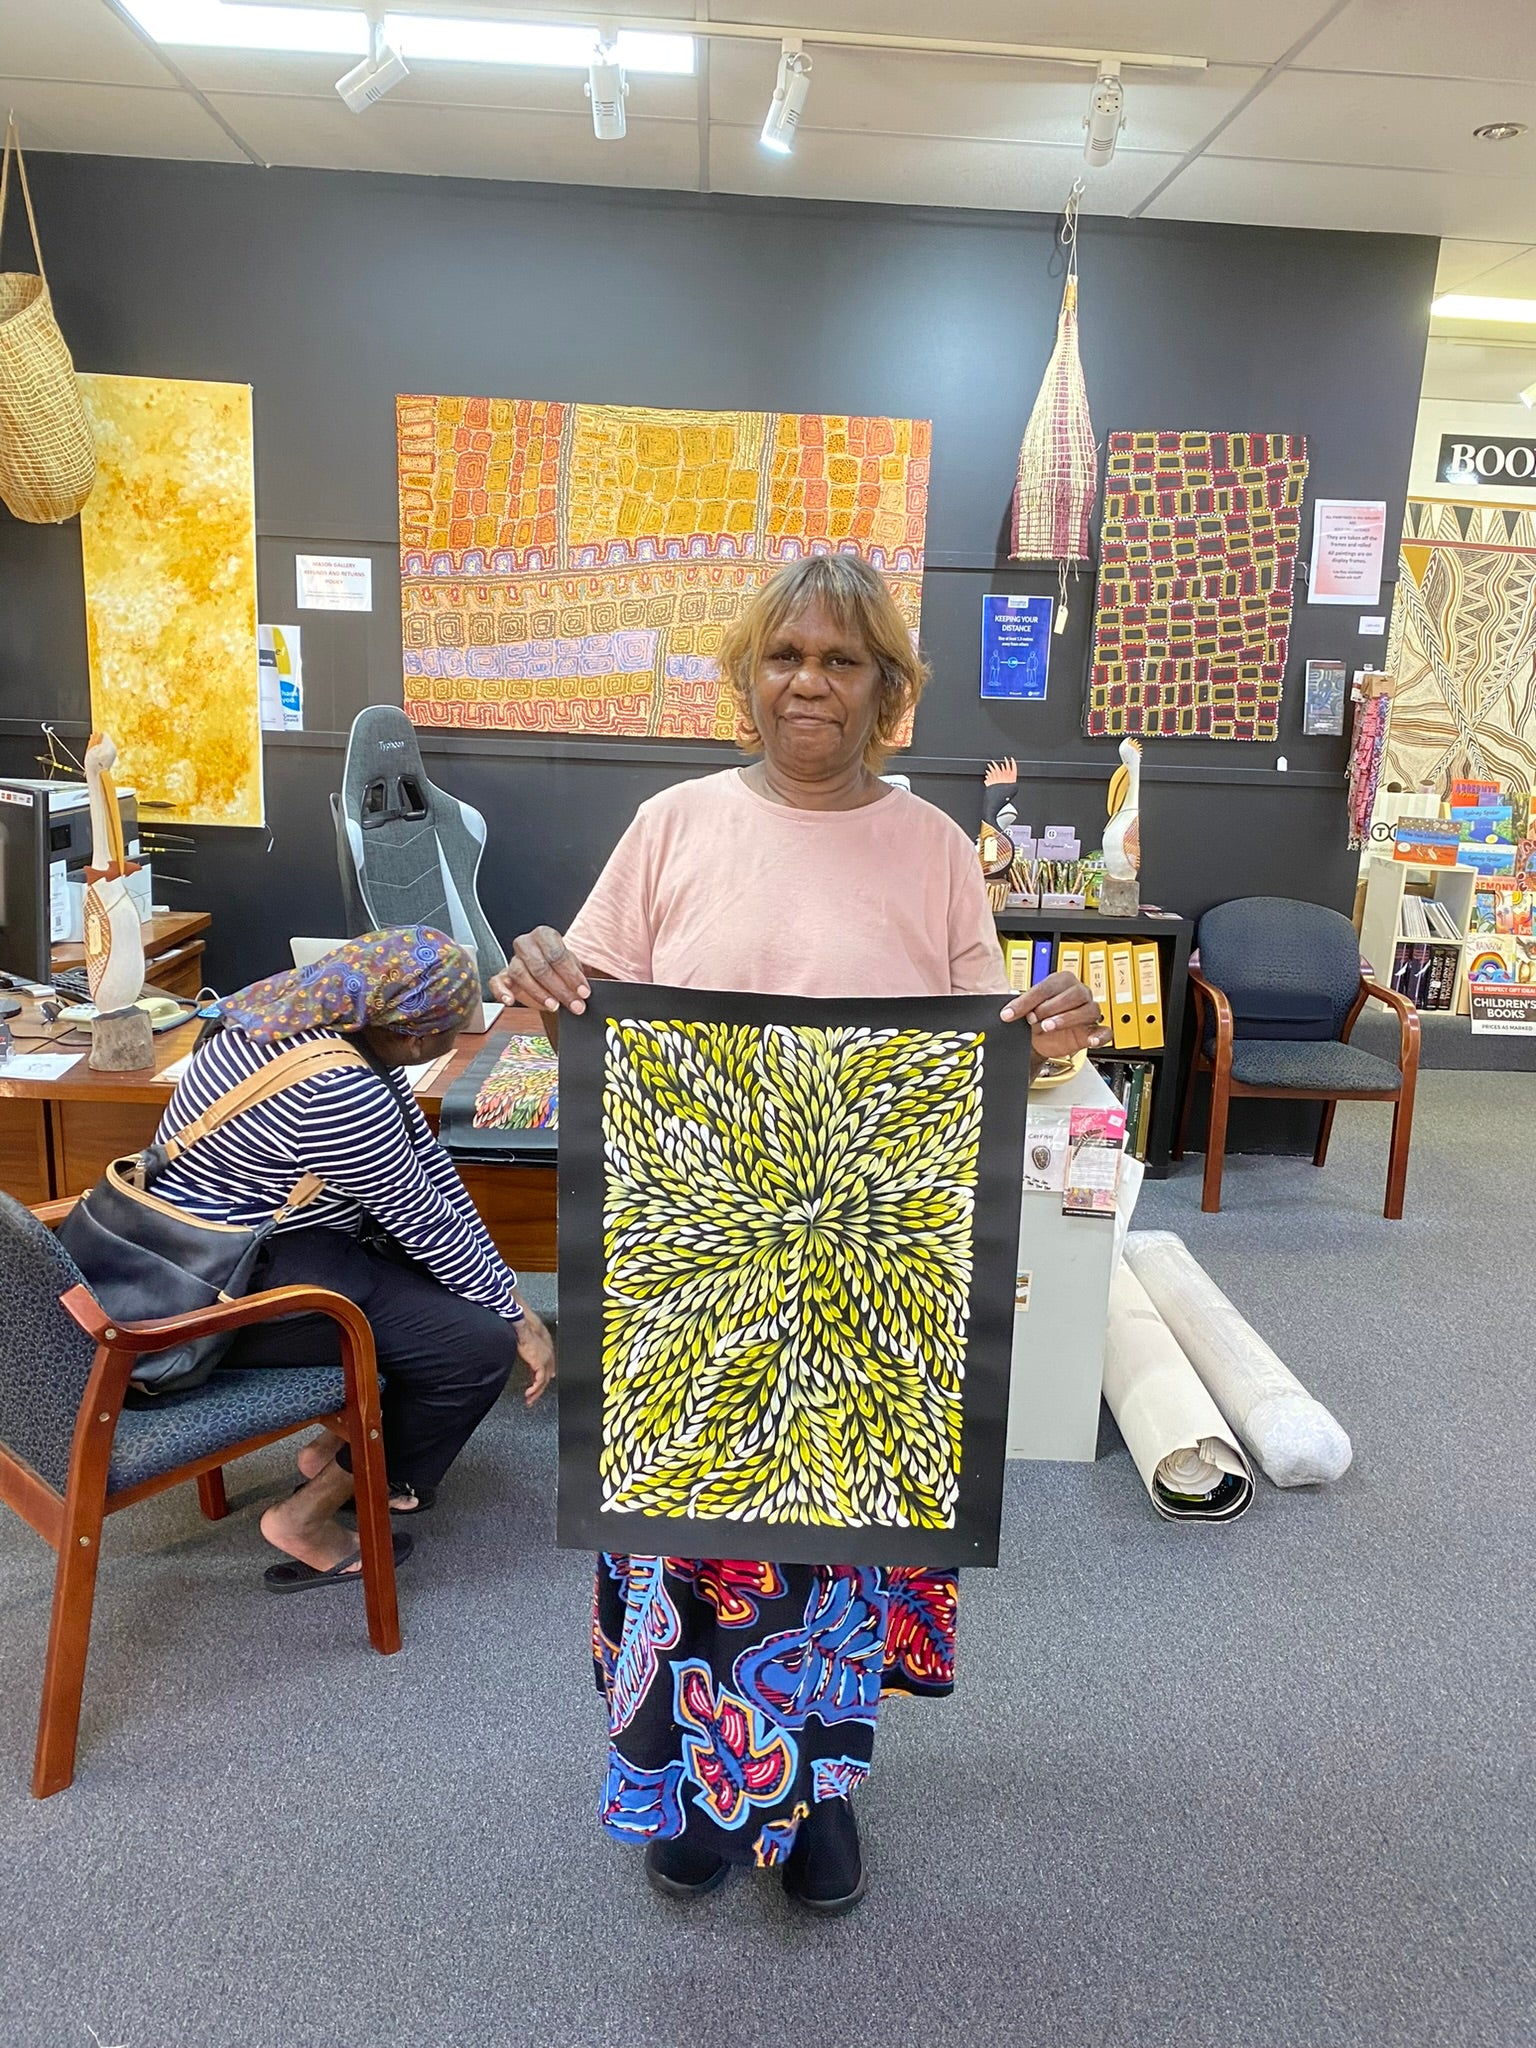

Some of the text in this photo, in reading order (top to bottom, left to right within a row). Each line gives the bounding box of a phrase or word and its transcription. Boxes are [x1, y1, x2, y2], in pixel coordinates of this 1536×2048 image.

[1450, 444, 1536, 478] BOO
[994, 615, 1039, 624] KEEPING YOUR
[1001, 624, 1032, 633] DISTANCE
[1475, 882, 1515, 891] REMONY
[1445, 956, 1456, 999] ABORIGINAL
[1473, 997, 1536, 1010] CHILDREN'S
[1487, 1008, 1526, 1019] BOOKS
